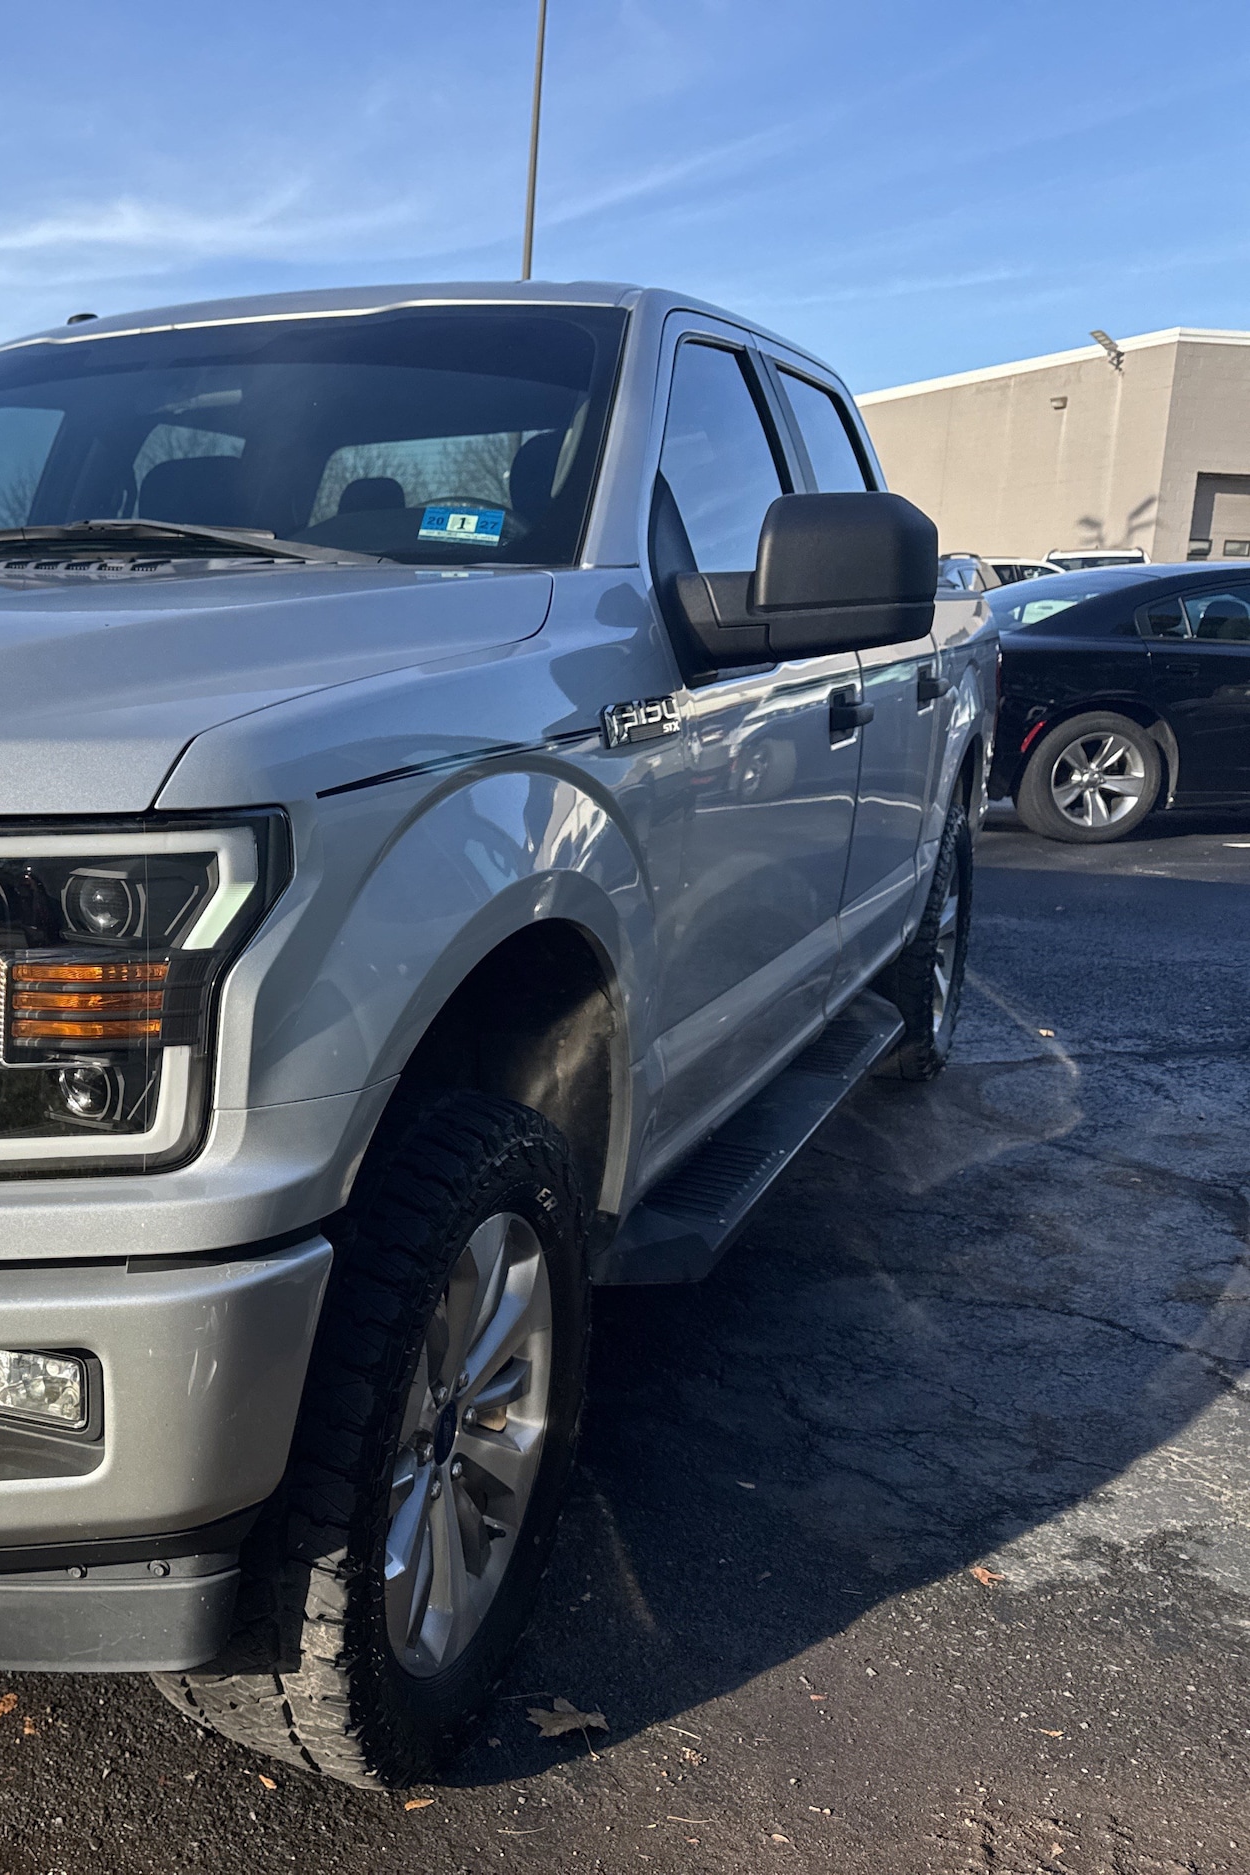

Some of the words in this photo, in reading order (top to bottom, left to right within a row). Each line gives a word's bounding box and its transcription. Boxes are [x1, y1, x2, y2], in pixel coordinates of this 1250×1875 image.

[426, 516, 445, 526] 20
[456, 517, 467, 530] 1
[480, 520, 499, 530] 27
[662, 721, 681, 733] STX
